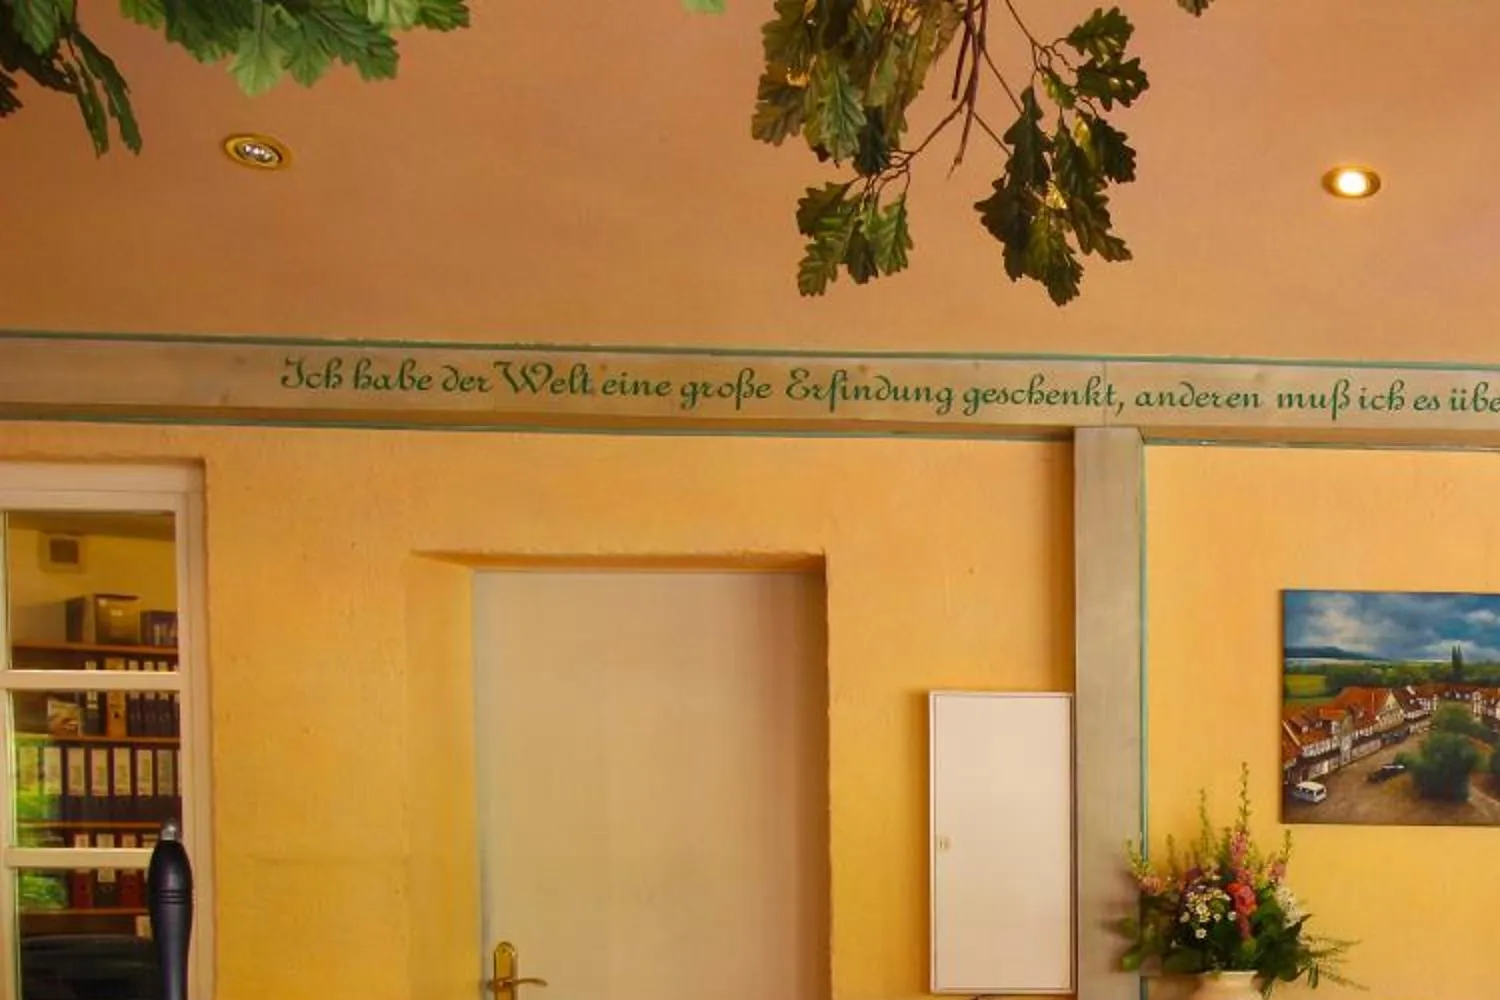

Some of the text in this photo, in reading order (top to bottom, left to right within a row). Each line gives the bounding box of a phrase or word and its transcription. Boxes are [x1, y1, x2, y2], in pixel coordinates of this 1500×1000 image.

[280, 355, 343, 391] Ich
[353, 356, 433, 393] habe
[441, 364, 494, 394] der
[494, 361, 592, 395] Welt
[602, 370, 672, 397] eine
[680, 367, 771, 411] große
[784, 365, 954, 416] Erfindung
[962, 374, 1126, 416] geschenkt,
[1135, 380, 1260, 409] anderen
[1276, 379, 1351, 421] muß
[1359, 379, 1405, 412] ich
[1413, 392, 1441, 412] es
